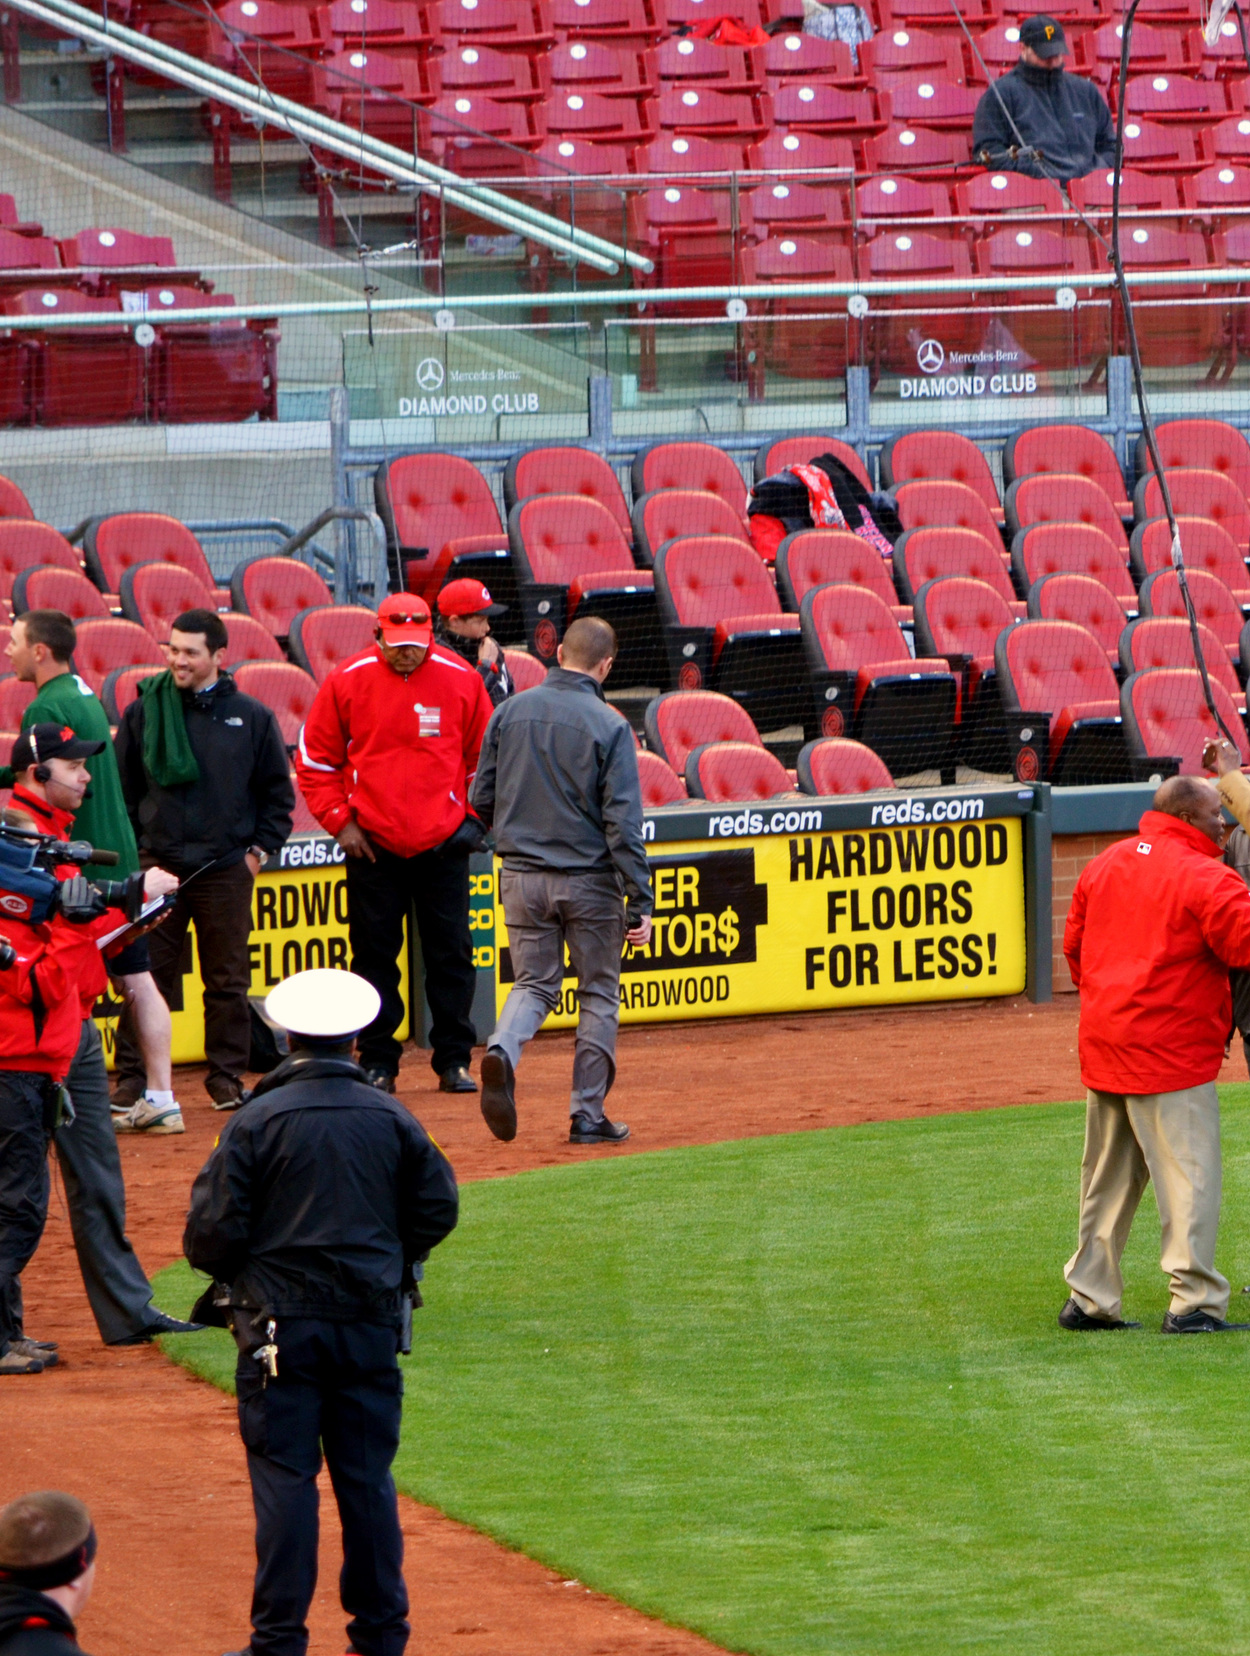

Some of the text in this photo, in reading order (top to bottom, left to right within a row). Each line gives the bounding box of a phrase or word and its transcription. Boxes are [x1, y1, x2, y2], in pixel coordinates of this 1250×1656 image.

[949, 349, 1018, 364] Mercedes-Benz
[900, 373, 1037, 398] DIAMOND CLUB
[399, 393, 540, 416] DIAMOND CLUB
[708, 809, 822, 837] reds.com
[871, 798, 984, 825] reds.com
[788, 823, 1008, 882] HARDWOOD
[827, 880, 973, 934] FLOORS
[805, 932, 997, 991] FOR LESS!
